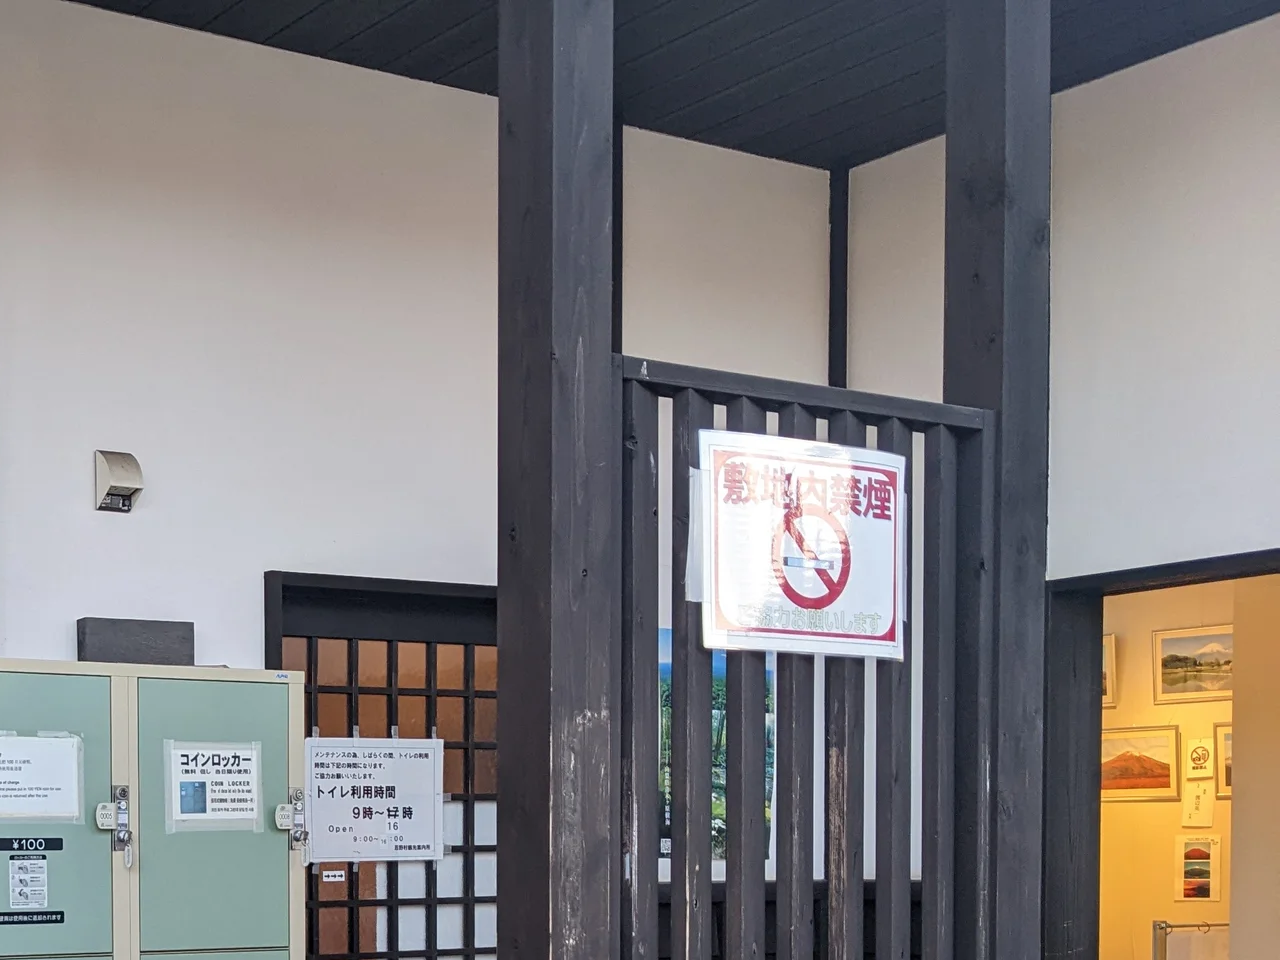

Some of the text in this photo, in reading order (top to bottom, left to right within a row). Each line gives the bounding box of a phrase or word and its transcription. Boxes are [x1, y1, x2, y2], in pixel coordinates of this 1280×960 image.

[723, 462, 892, 521] 敷地内禁煙
[737, 604, 882, 634] ご協力お願いします
[180, 752, 252, 767] コインロッカー
[317, 785, 396, 799] トイレ利用時間
[388, 822, 398, 830] 16
[13, 839, 45, 850] ¥100
